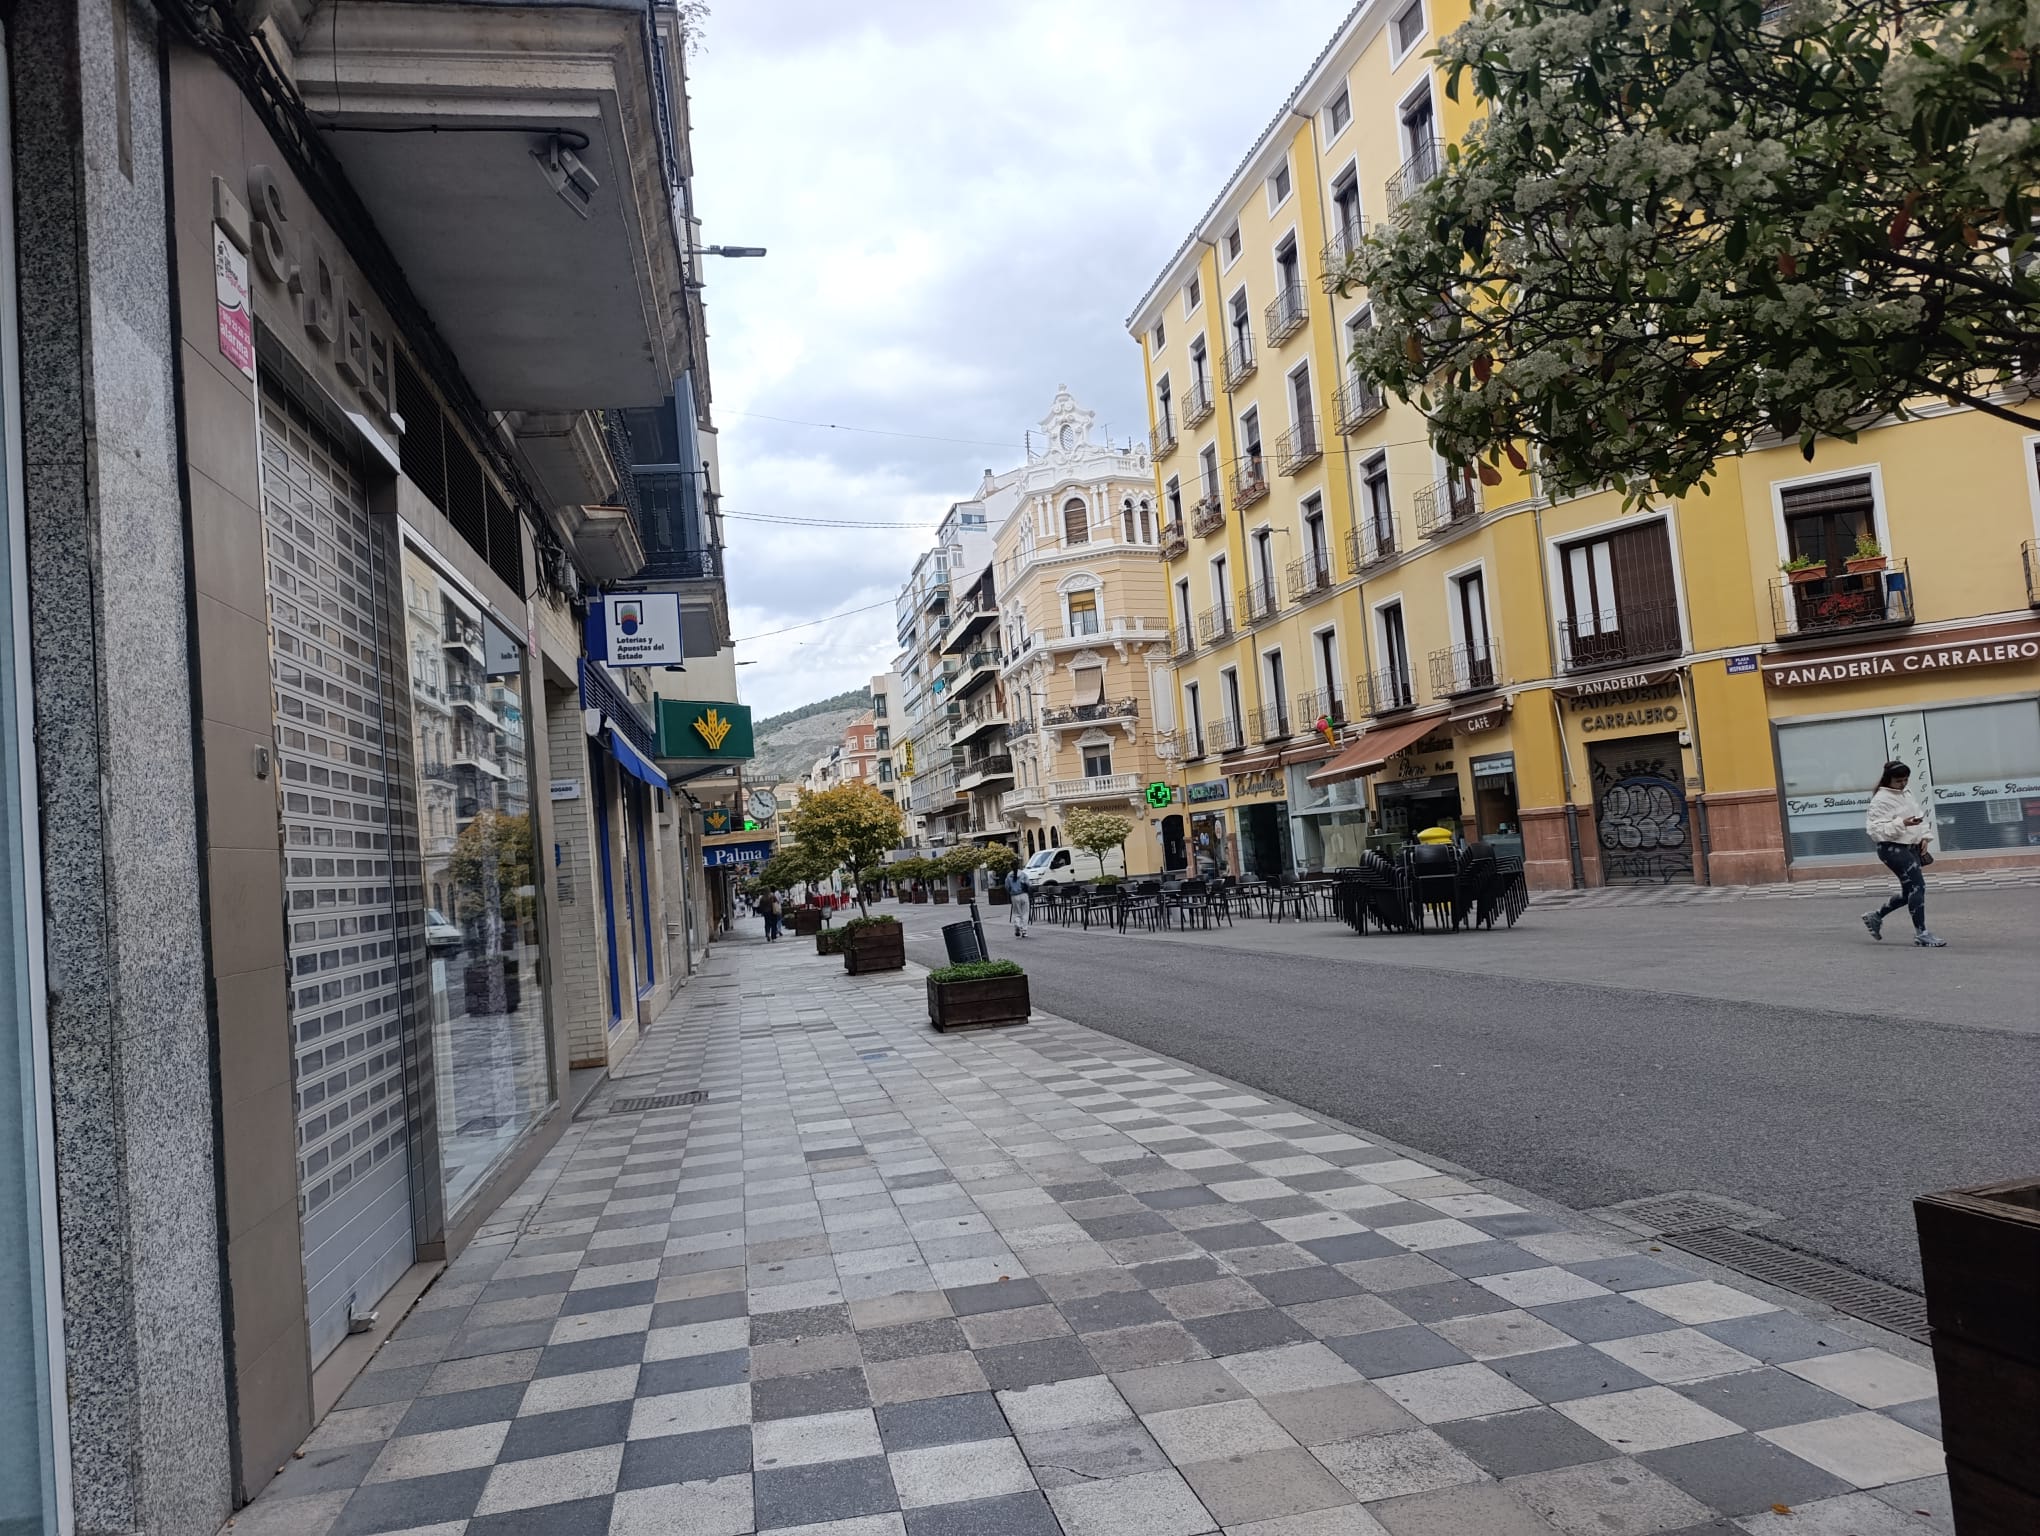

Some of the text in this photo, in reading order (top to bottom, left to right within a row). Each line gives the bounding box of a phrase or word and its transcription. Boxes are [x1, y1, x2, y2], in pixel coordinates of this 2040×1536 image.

[219, 322, 249, 360] alarma
[648, 637, 653, 645] y
[617, 643, 665, 653] Apuestas del
[617, 652, 643, 660] Estado
[1774, 641, 2040, 686] PANADERÍA CARRALERO
[1581, 705, 1678, 733] CARRALERO
[1971, 785, 1998, 797] Tapas
[1787, 800, 1818, 813] Gofres
[714, 847, 763, 865] Palma
